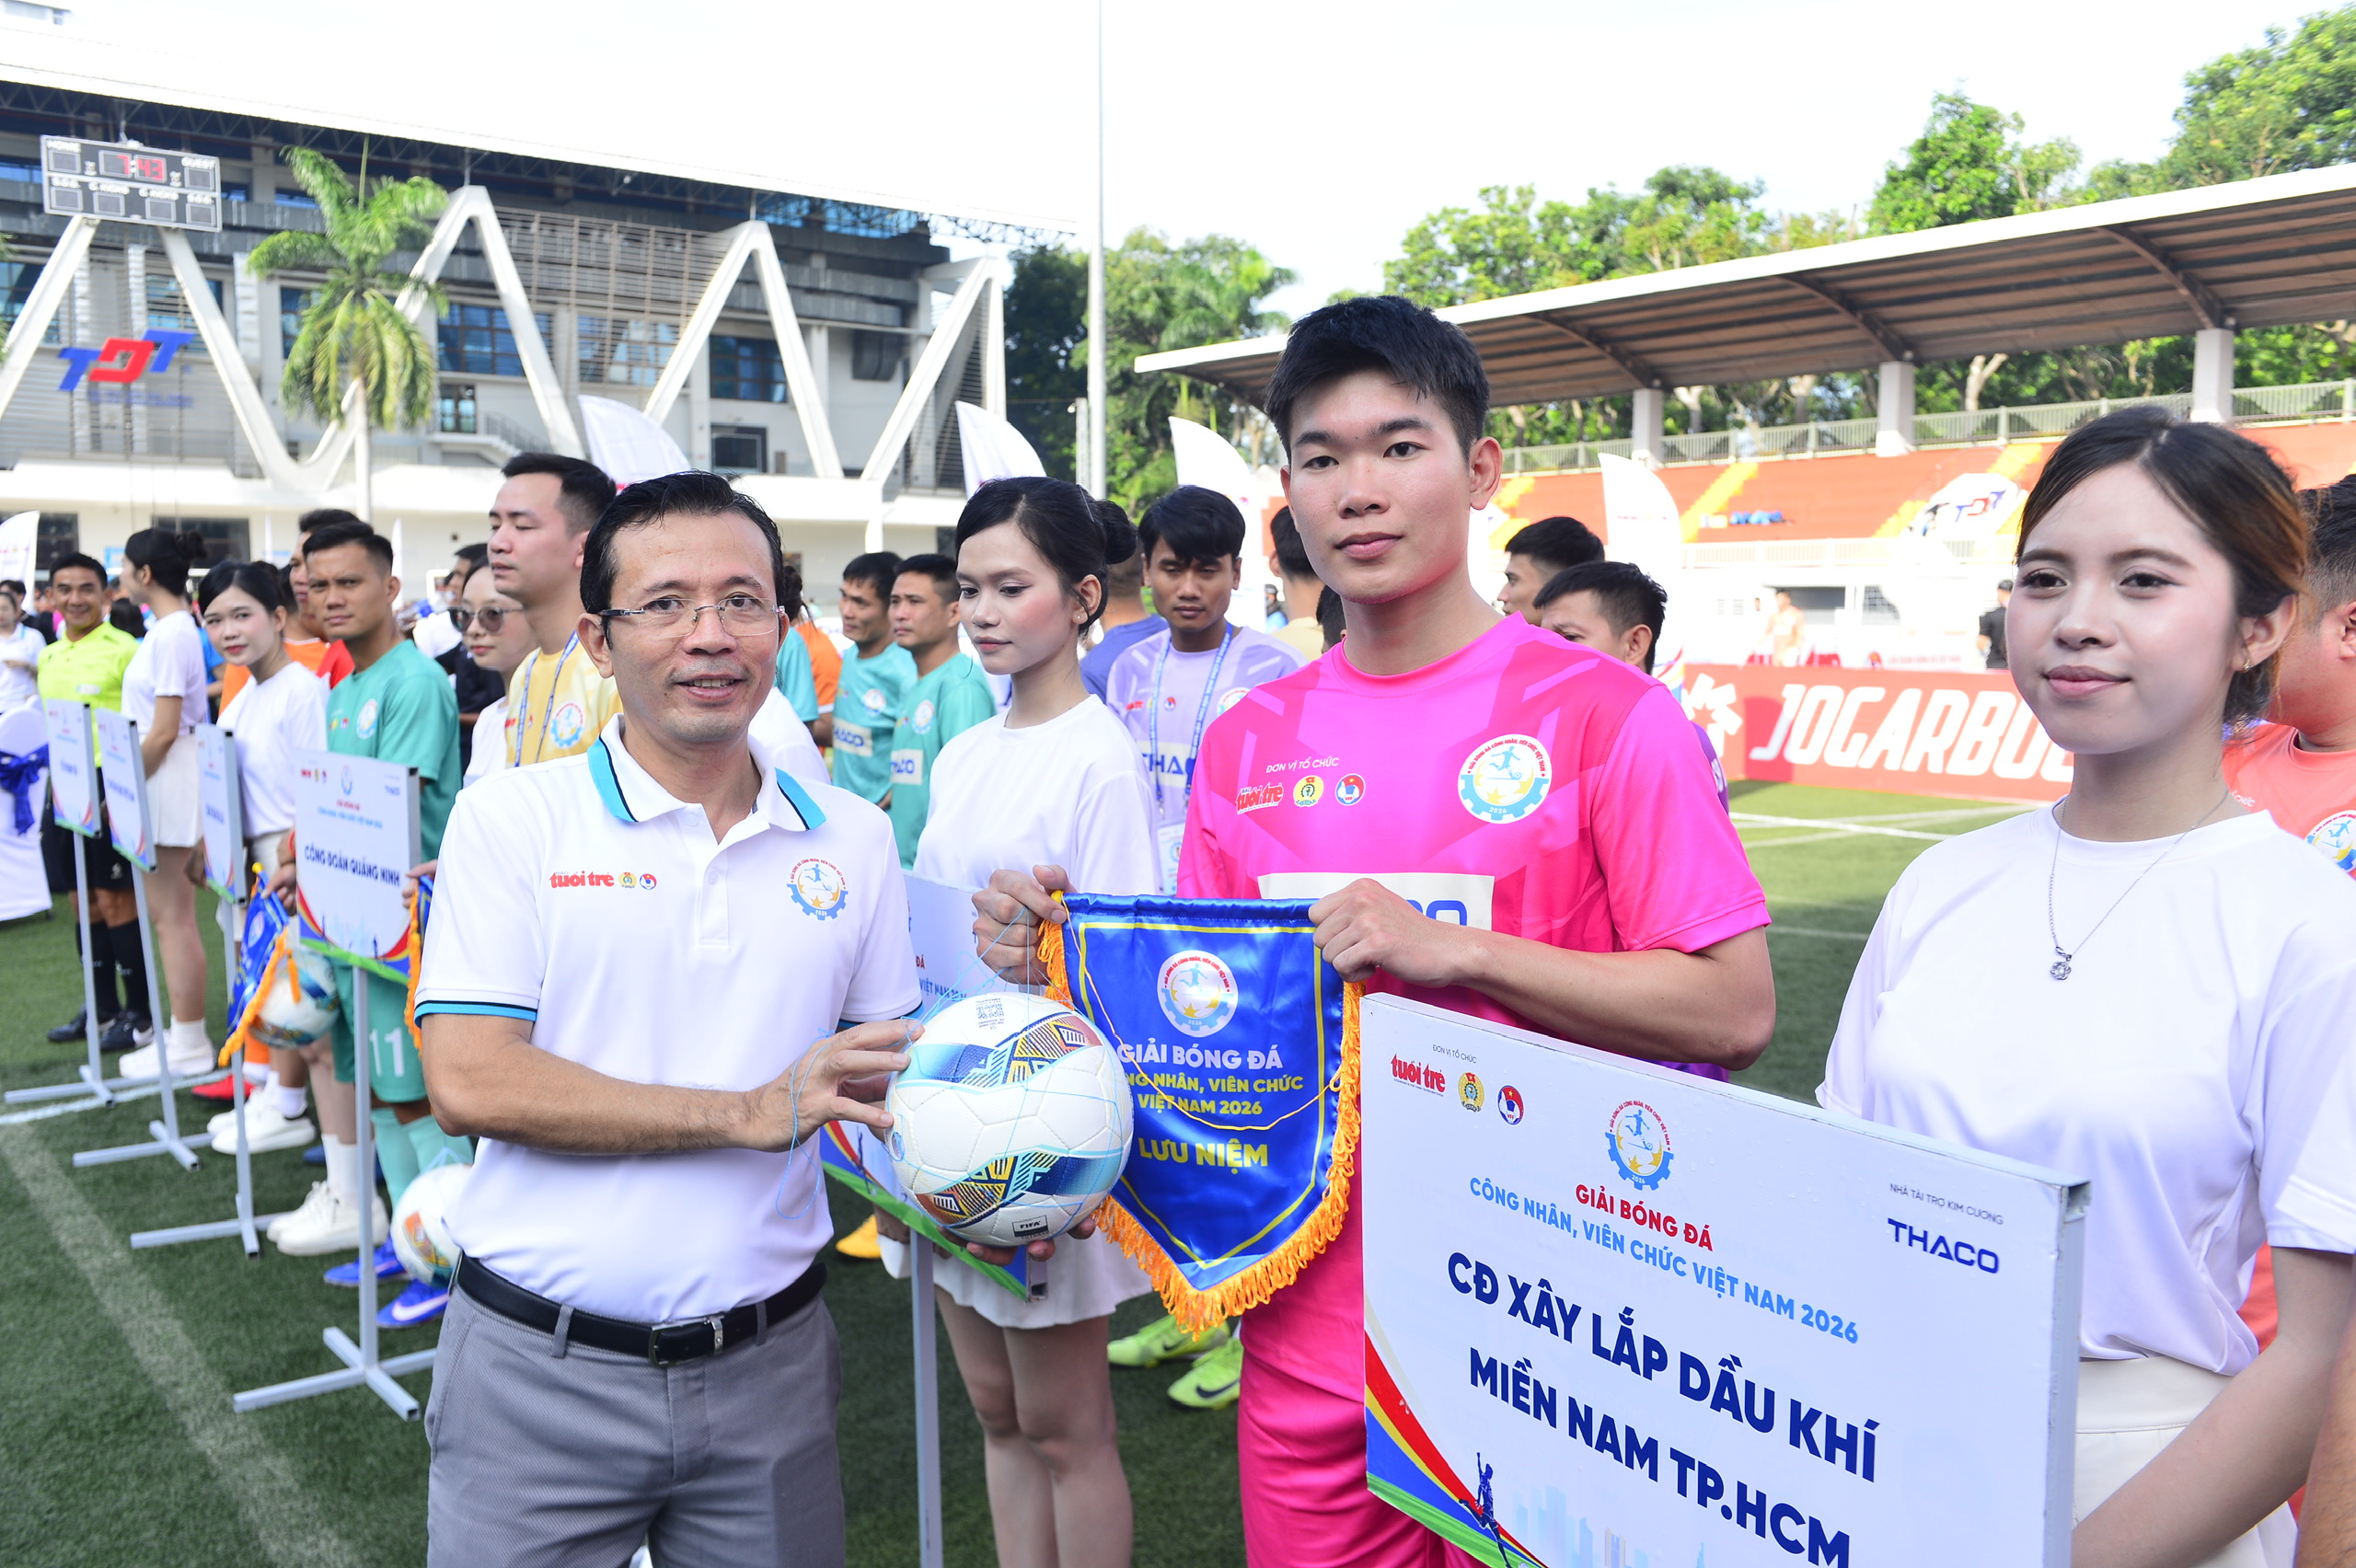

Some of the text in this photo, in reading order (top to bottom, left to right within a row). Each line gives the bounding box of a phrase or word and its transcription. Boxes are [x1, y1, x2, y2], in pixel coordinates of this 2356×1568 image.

[380, 868, 400, 887] NINH
[369, 1028, 404, 1077] 11
[1116, 1037, 1283, 1069] GIẢI BÓNG ĐÁ
[1126, 1072, 1304, 1094] NG NHÂN, VIÊN CHỨC
[1138, 1093, 1264, 1115] VIỆT NAM 2026
[1138, 1137, 1268, 1174] LƯU NIỆM
[1576, 1184, 1714, 1252] GIẢI BÓNG ĐÁ
[1947, 1201, 1964, 1213] KIM
[1470, 1177, 1859, 1344] CÔNG NHÂN, VIÊN CHỨC VIỆT NAM 2026
[1888, 1217, 1999, 1274] THACO
[1448, 1252, 1880, 1483] CĐ XÂY LẮP DẦU KHÍ
[1470, 1346, 1850, 1568] MIỀN NAM TP.HCM
